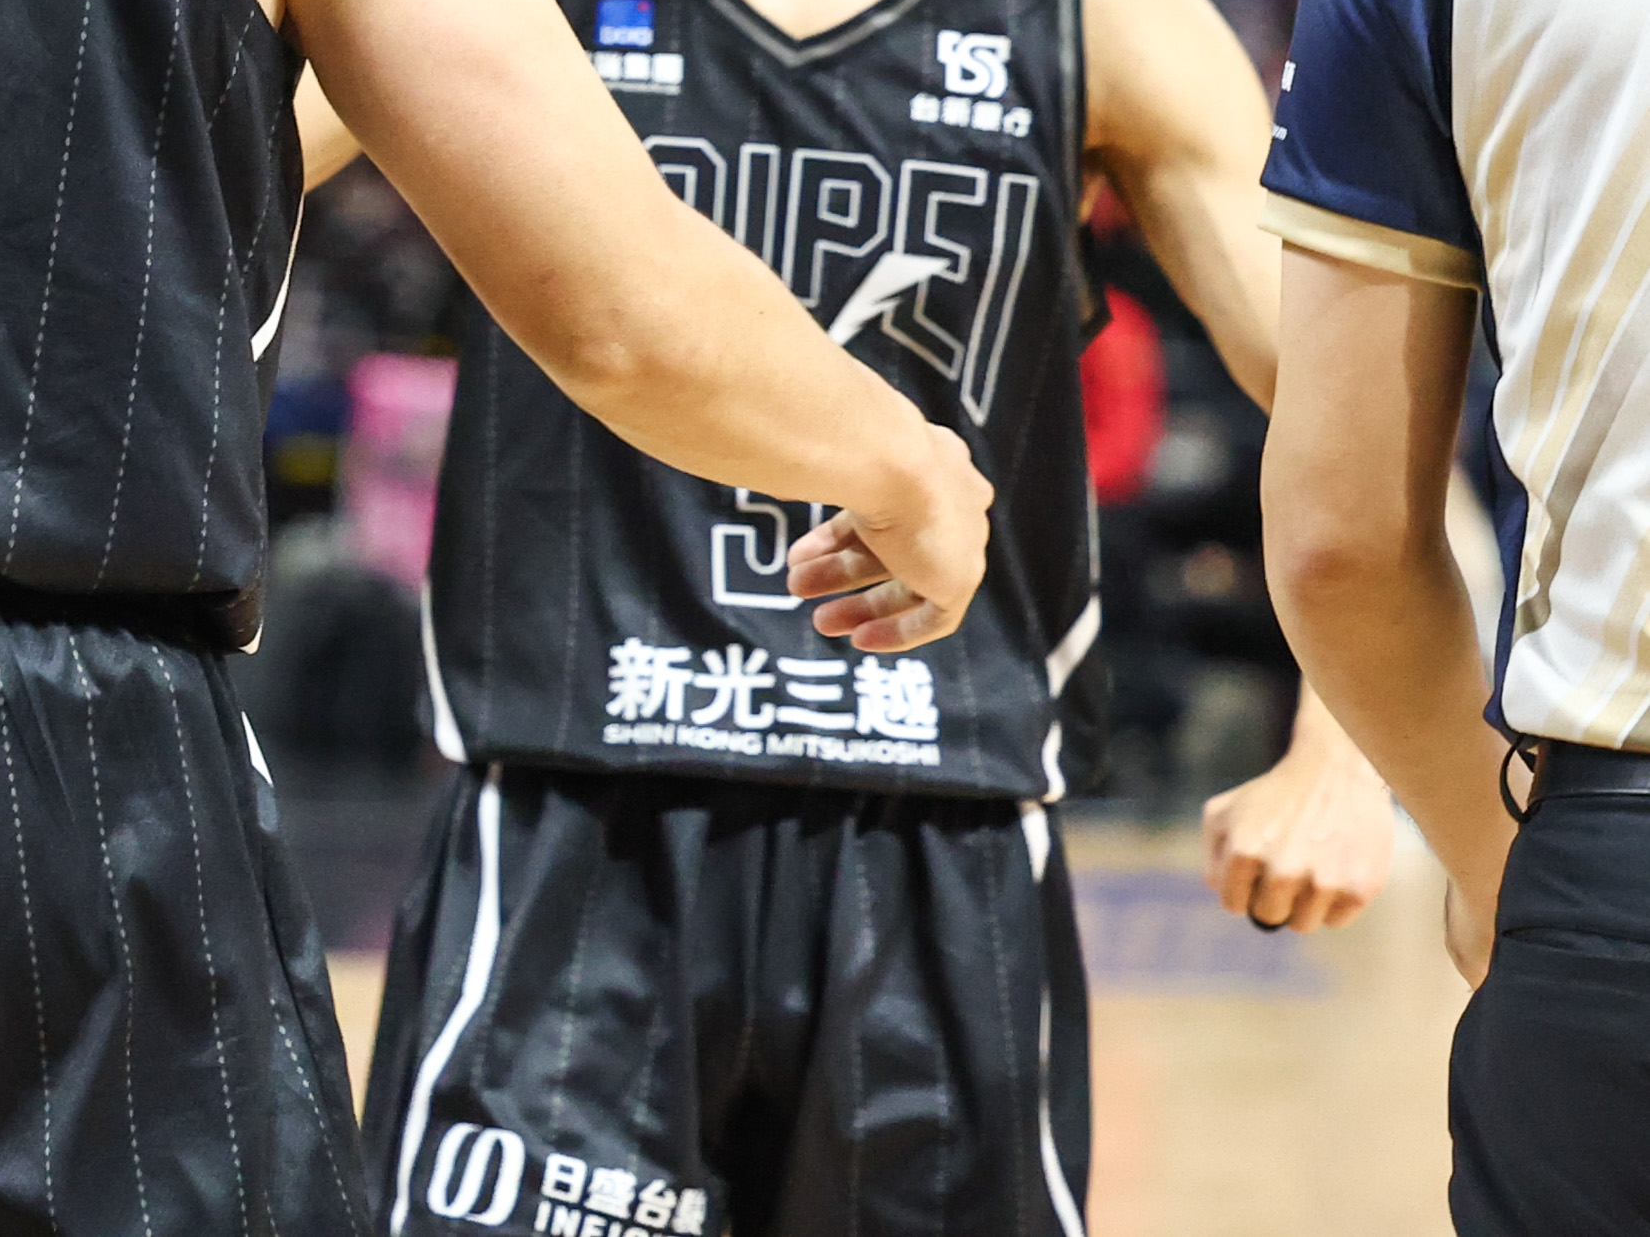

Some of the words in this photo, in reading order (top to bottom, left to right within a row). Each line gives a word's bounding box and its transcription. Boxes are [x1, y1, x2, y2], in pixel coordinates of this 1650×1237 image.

[605, 636, 940, 741] 新光三越
[676, 725, 764, 756] KONG
[766, 733, 942, 767] MITSUKOSHI
